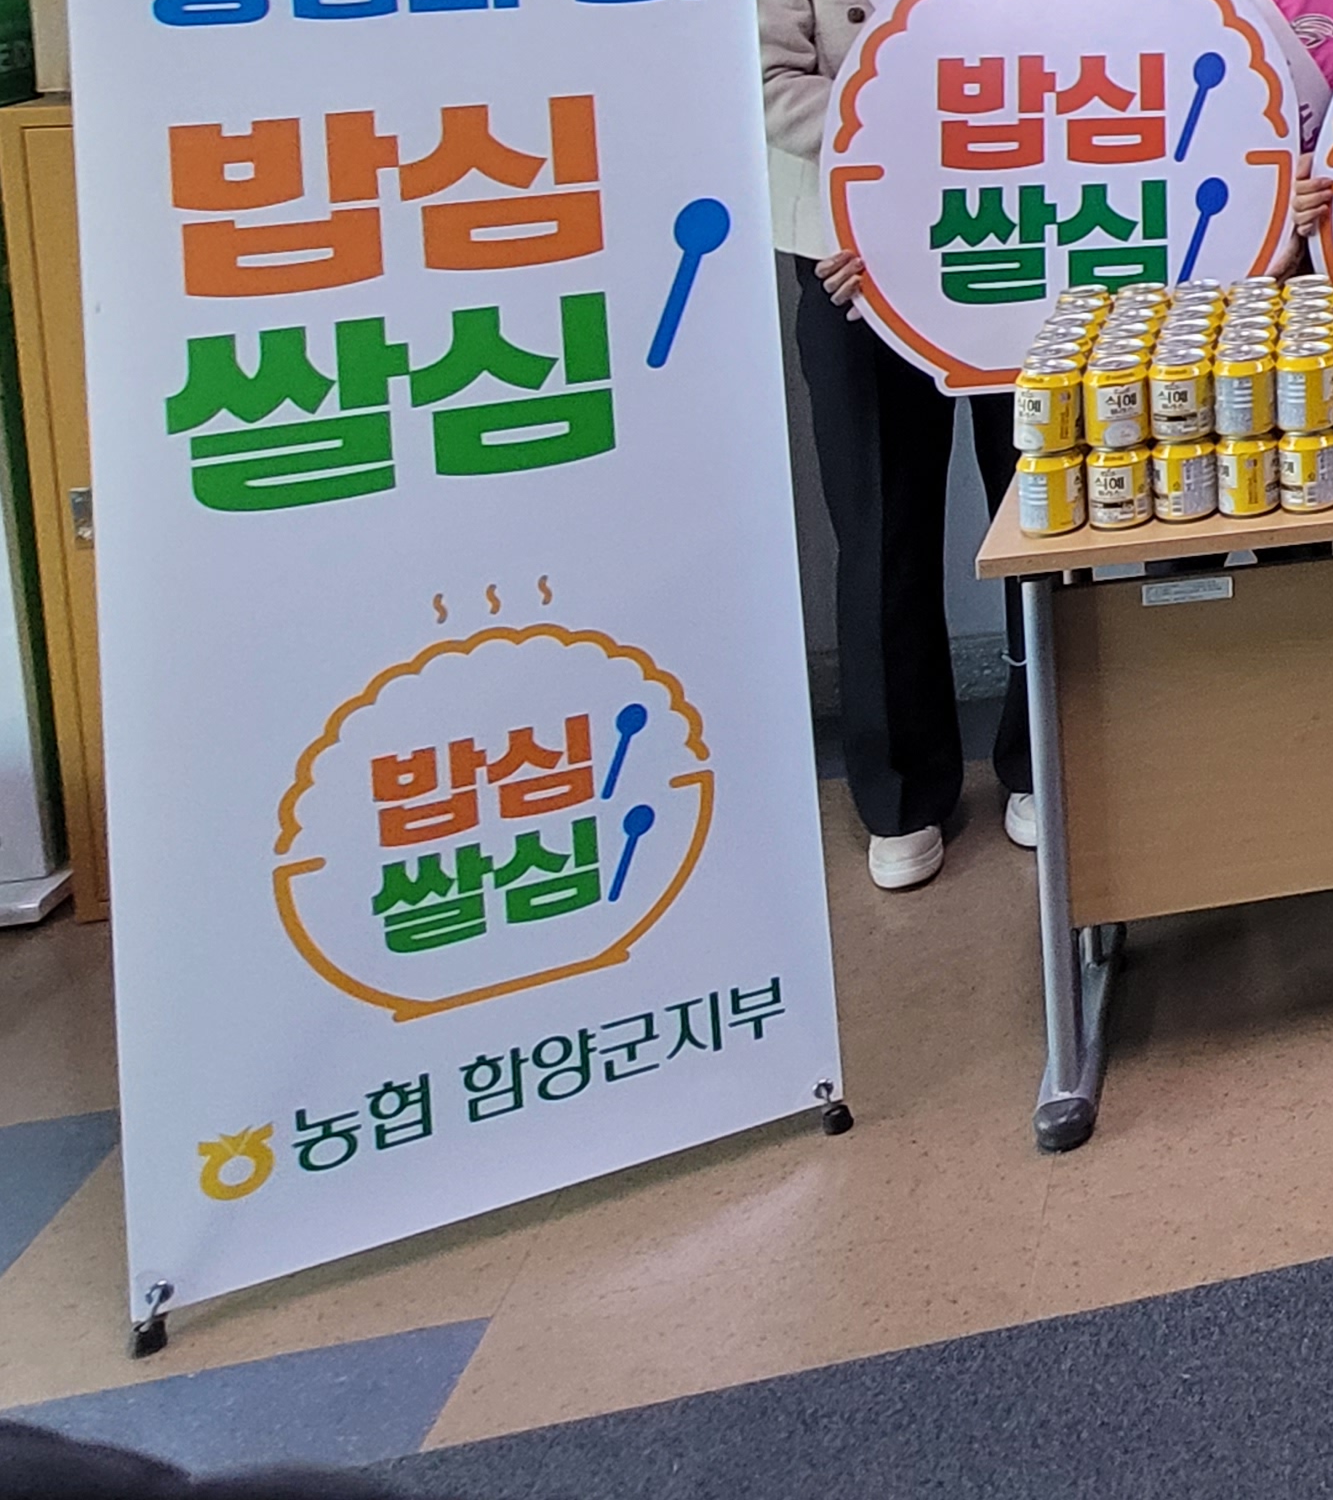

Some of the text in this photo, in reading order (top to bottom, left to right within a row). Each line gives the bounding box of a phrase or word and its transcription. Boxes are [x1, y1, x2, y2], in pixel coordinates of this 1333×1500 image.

[936, 52, 1166, 171] 밥심
[169, 95, 604, 298] 밥심
[929, 179, 1169, 305] 쌀심
[165, 291, 616, 513] 쌀심
[371, 713, 594, 848] 밥심
[371, 817, 602, 954] 쌀심
[292, 977, 787, 1173] 농협 함양군지부
